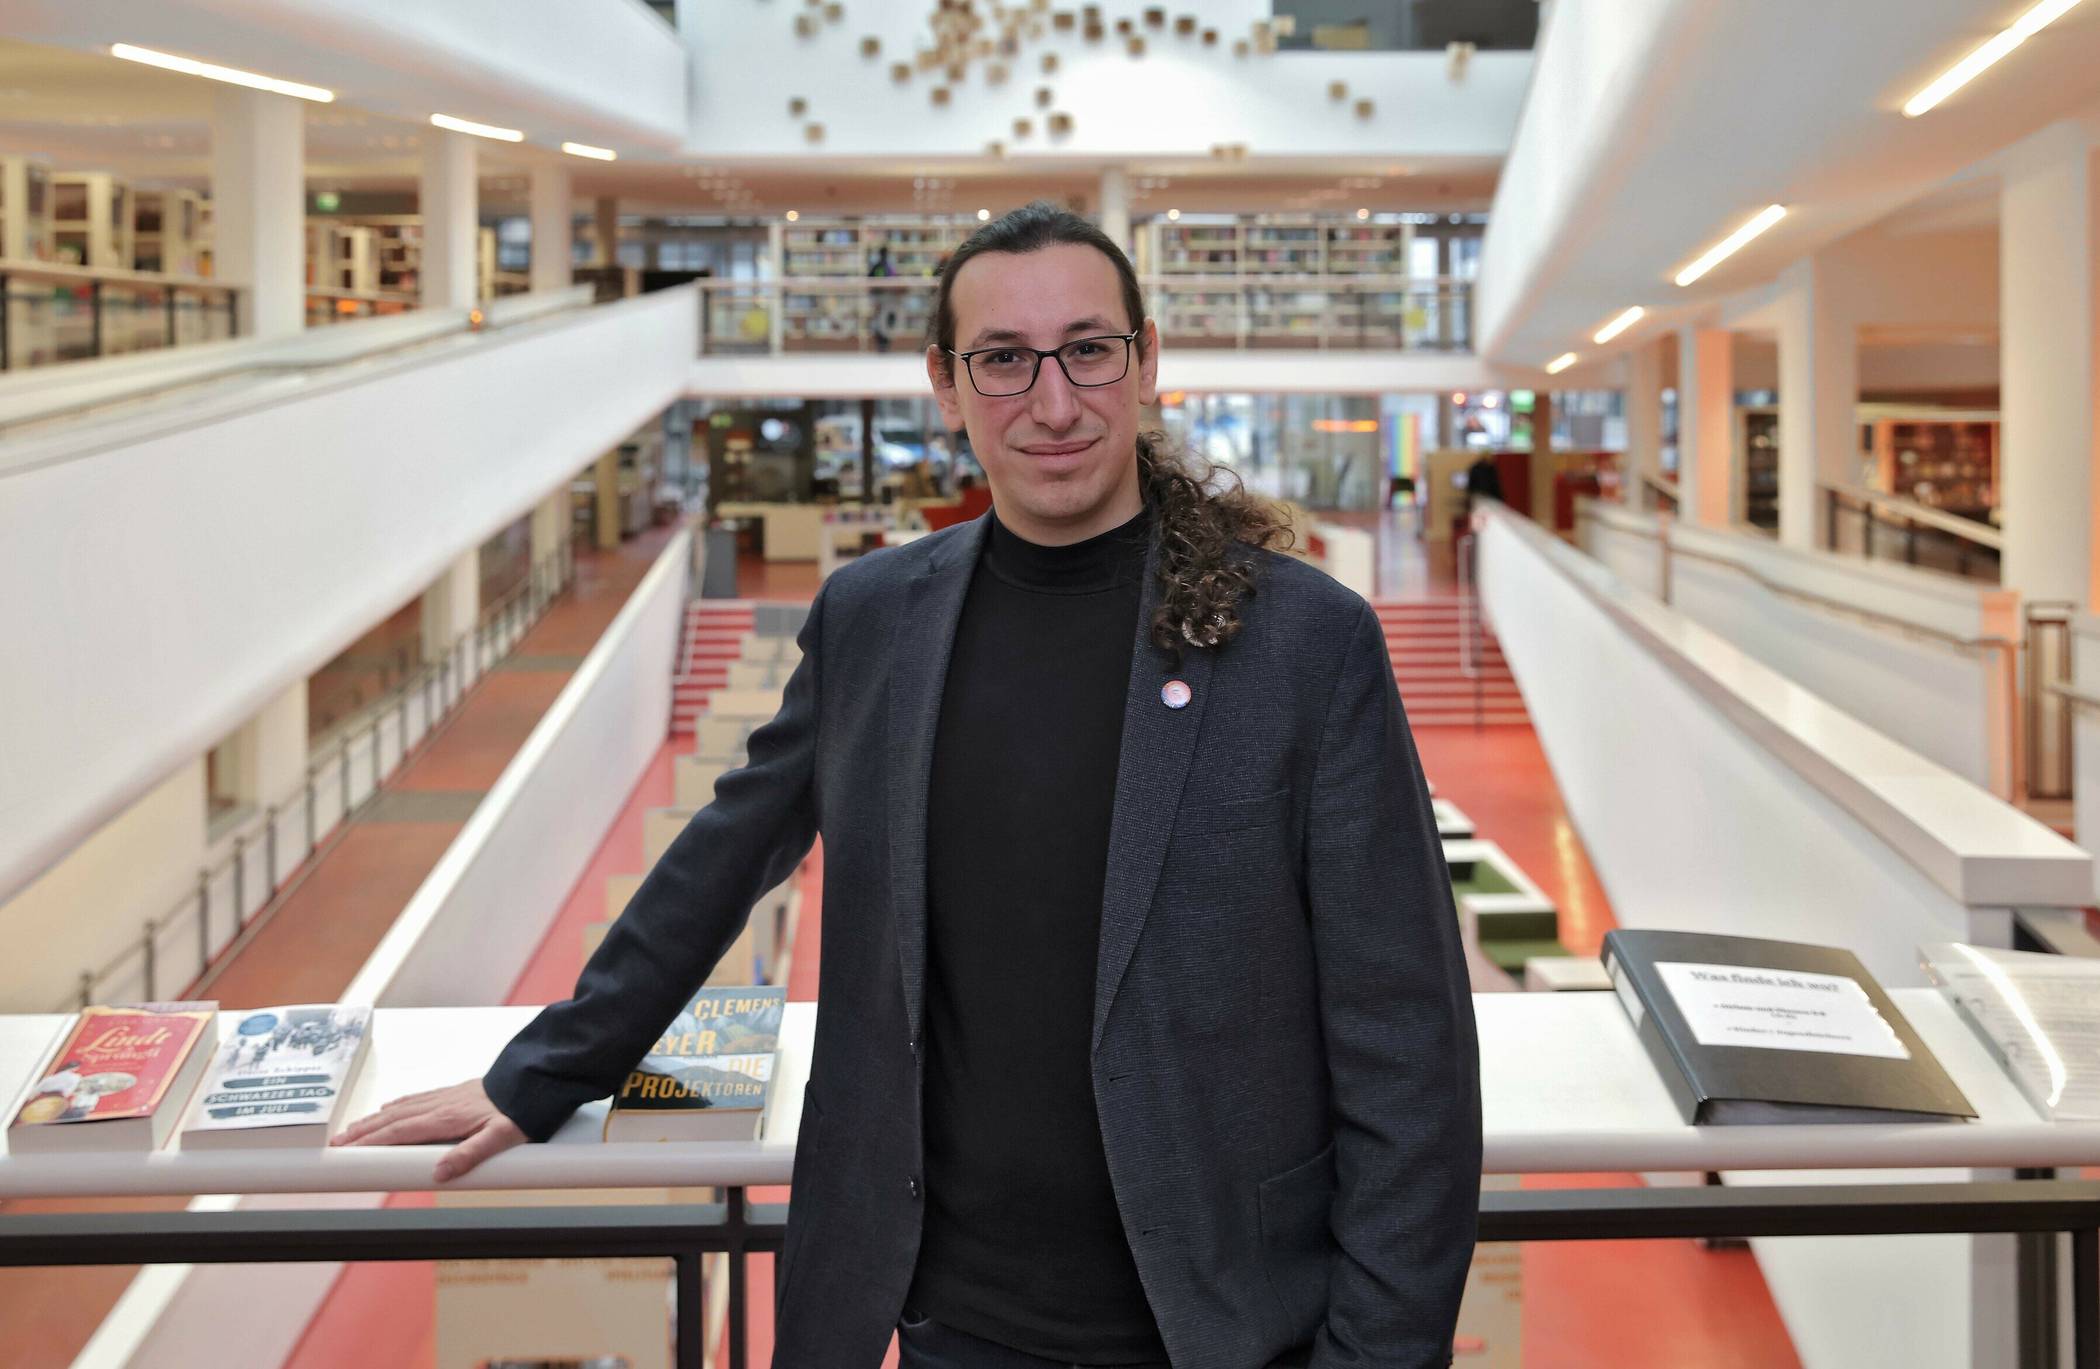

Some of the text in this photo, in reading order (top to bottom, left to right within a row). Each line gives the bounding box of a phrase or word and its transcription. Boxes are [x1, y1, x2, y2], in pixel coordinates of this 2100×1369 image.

[694, 997, 780, 1020] CLEMENS
[651, 1029, 717, 1055] EYER
[728, 1057, 766, 1076] DIE
[262, 1076, 288, 1086] EIN
[621, 1071, 763, 1099] PROJEKTOREN
[206, 1087, 327, 1104] SCHWARZER TAG
[261, 1104, 289, 1114] JULI
